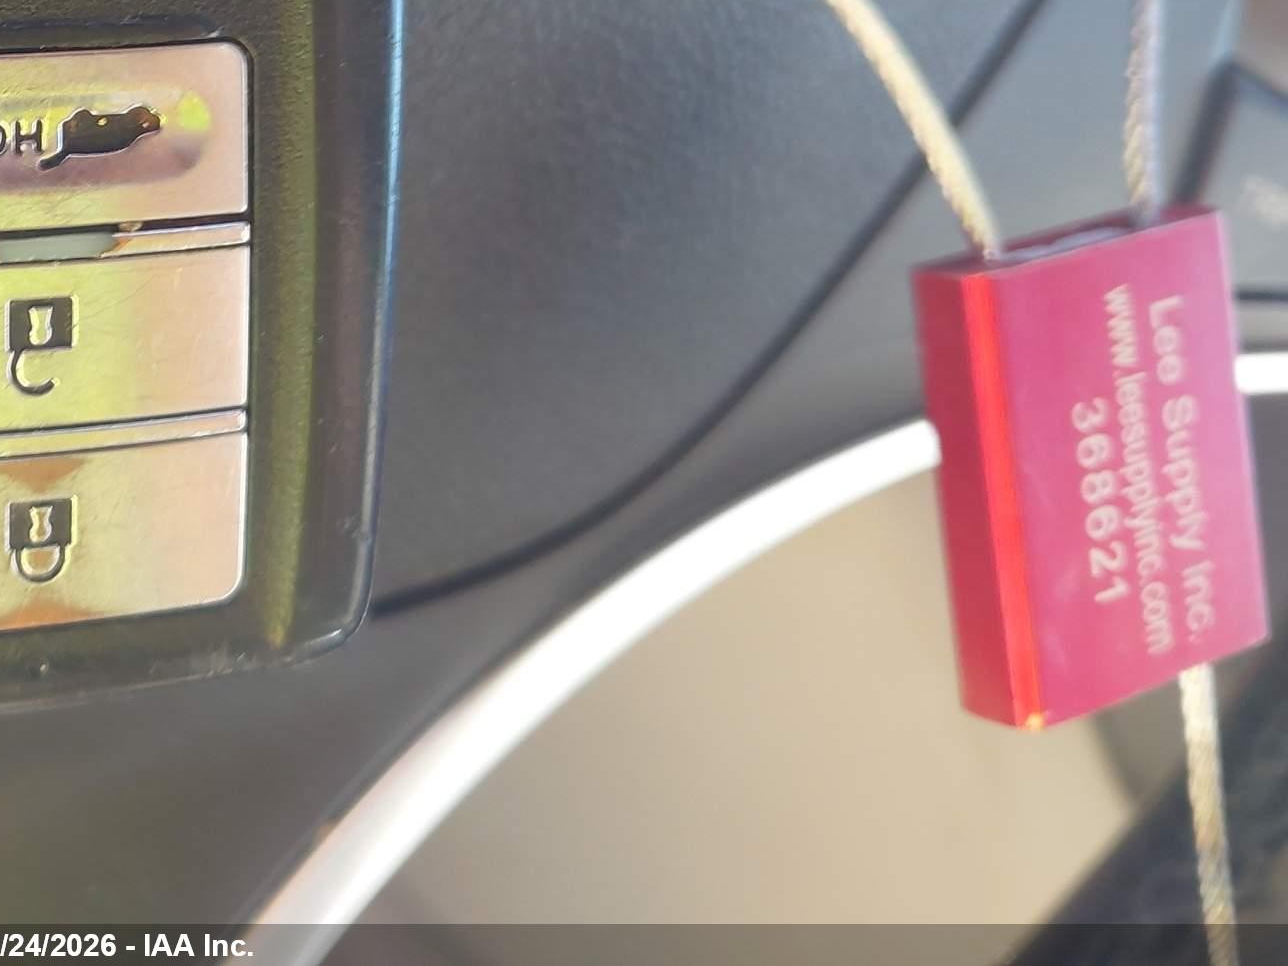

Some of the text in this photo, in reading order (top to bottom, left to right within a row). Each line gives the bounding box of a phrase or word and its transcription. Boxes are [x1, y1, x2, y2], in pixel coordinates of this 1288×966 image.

[1071, 397, 1130, 603] 368621
[1103, 283, 1174, 656] www.leesupplyinc.com
[1148, 294, 1213, 643] Lee Supply Inc.
